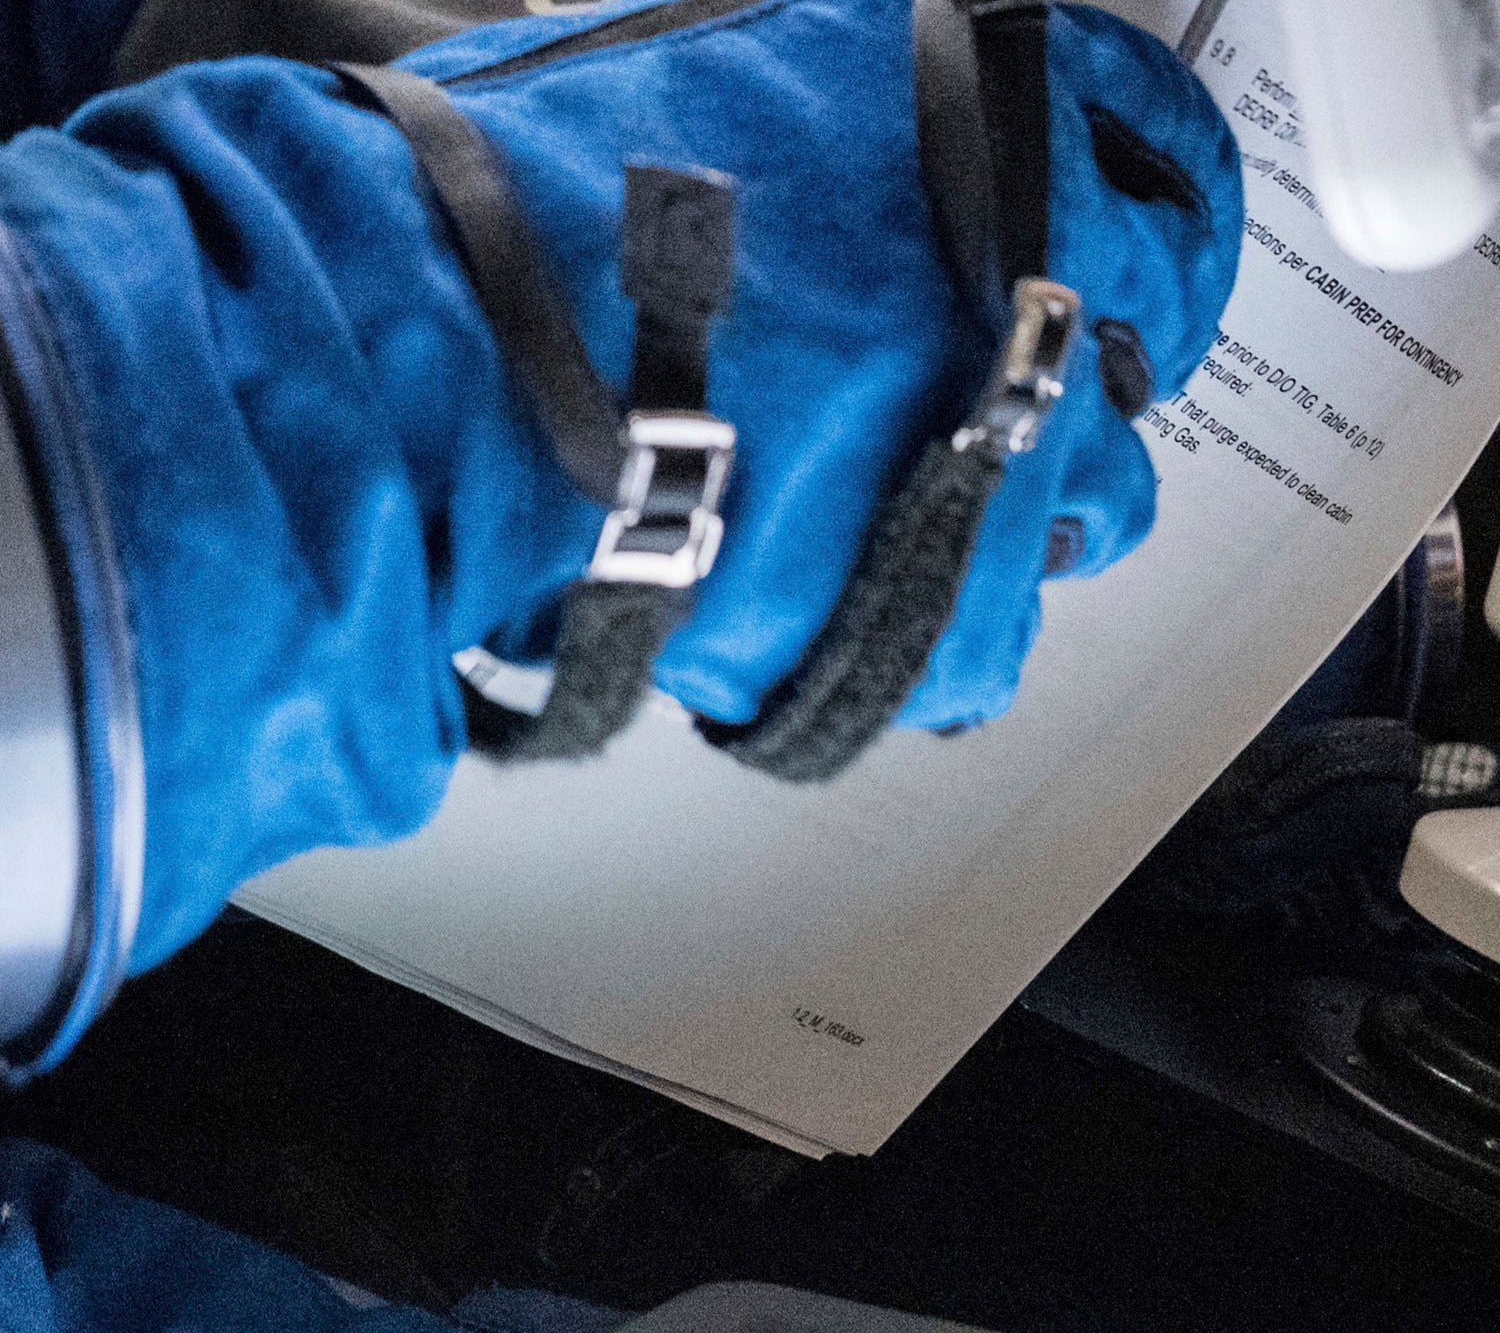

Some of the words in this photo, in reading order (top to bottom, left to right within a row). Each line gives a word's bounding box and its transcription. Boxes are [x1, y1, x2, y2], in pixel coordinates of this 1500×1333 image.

[1280, 251, 1308, 272] per
[1305, 266, 1352, 305] CABIN
[1344, 295, 1383, 328] PREP
[1376, 319, 1405, 347] FOR
[1399, 336, 1464, 388] CONTINGENCY
[1201, 355, 1252, 397] required:
[1224, 339, 1259, 367] prior
[1253, 357, 1270, 376] to
[1267, 368, 1296, 392] D/O
[1292, 385, 1318, 414] TIG,
[1317, 403, 1348, 434] Table
[1345, 425, 1360, 439] 6
[1174, 427, 1201, 454] Gas.
[1180, 398, 1209, 424] that
[1201, 417, 1239, 446] purge
[1236, 440, 1290, 481] expected
[1284, 472, 1300, 489] to
[1297, 482, 1329, 509] clean
[1325, 502, 1353, 526] cabin
